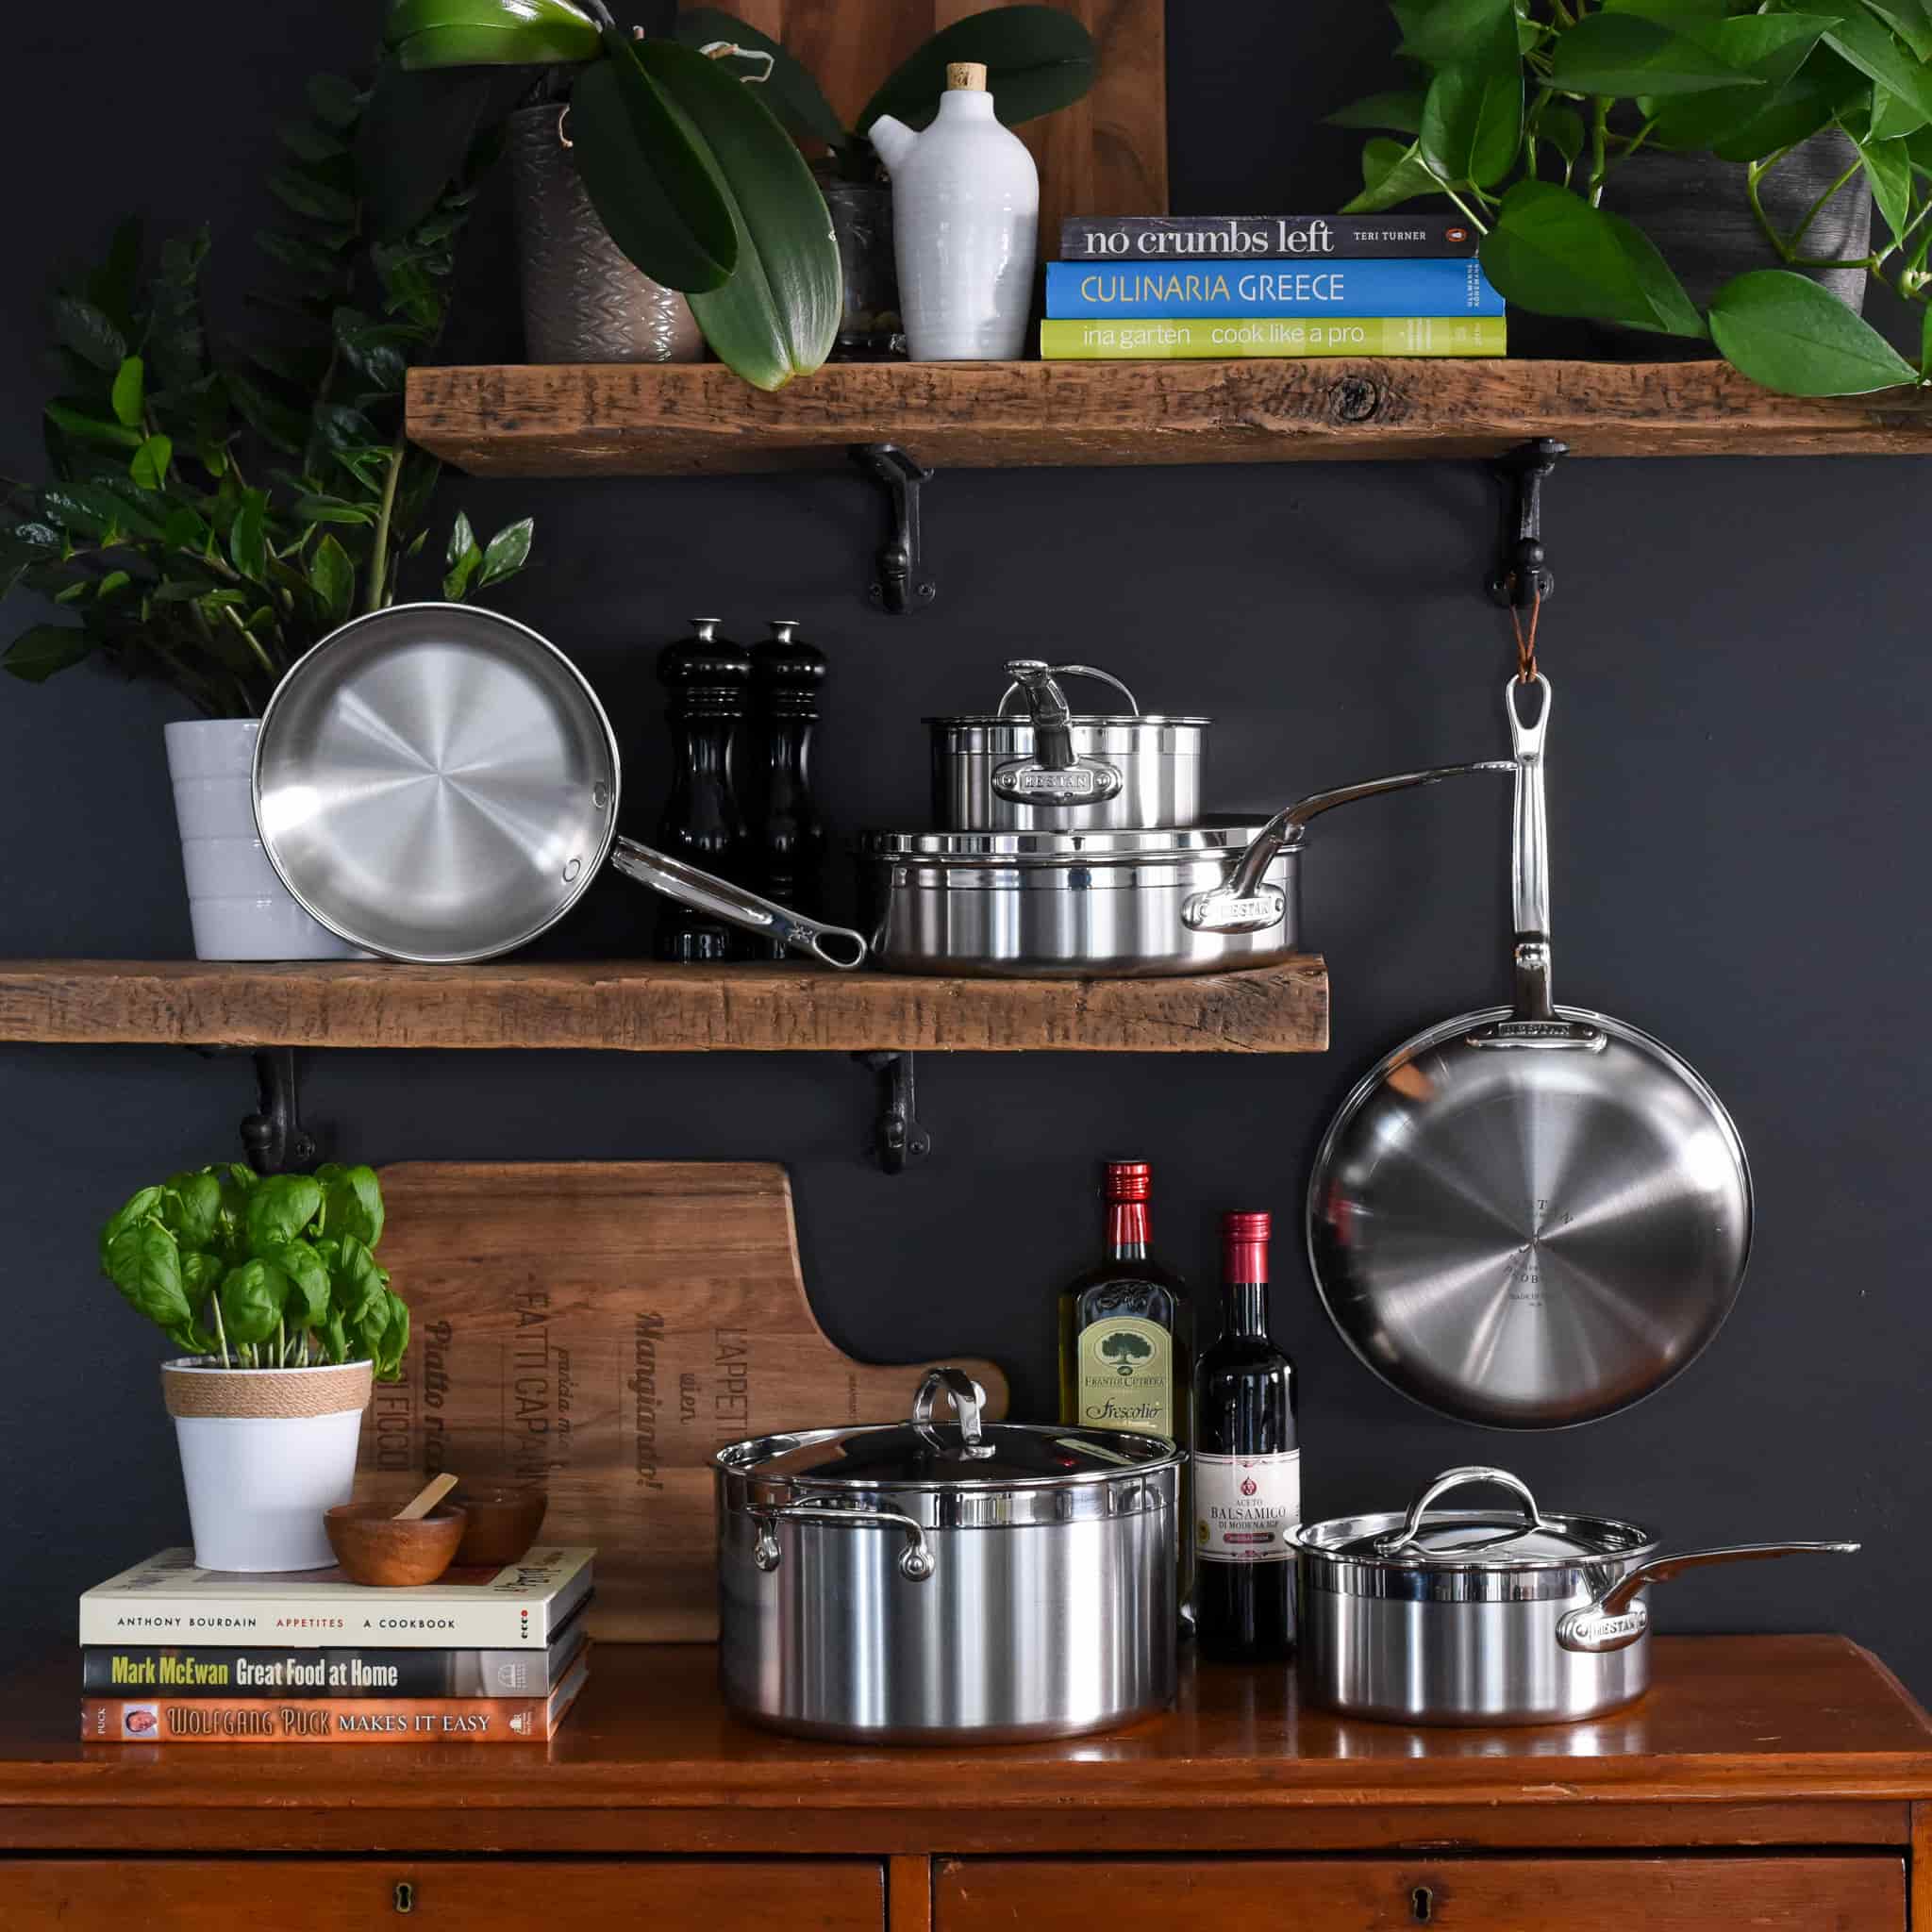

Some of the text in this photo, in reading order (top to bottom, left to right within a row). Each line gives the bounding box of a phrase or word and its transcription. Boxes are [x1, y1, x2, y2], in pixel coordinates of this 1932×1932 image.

[1083, 221, 1335, 254] no crumbs left
[1353, 231, 1426, 242] TERI TURNER
[1080, 274, 1344, 303] CULINARIA GREECE
[1083, 325, 1191, 349] ina garten
[1211, 324, 1365, 347] cook like a pro
[1224, 900, 1270, 918] ESTAN
[513, 1291, 550, 1370] FATTI
[425, 1319, 454, 1409] Piatto
[715, 1327, 749, 1443] L'APPETIT
[1210, 1507, 1287, 1520] BALSAMICO
[1218, 1521, 1227, 1529] DI
[1228, 1521, 1265, 1530] MODENA
[117, 1617, 456, 1629] ANTHONY BOURDAIN APPETITES A COOKBOOK
[111, 1657, 399, 1687] Mark McEwan Great Food at Home
[97, 1707, 107, 1735] PUCK
[167, 1707, 491, 1736] WOLFGANG PUCK MAKES IT EASY
